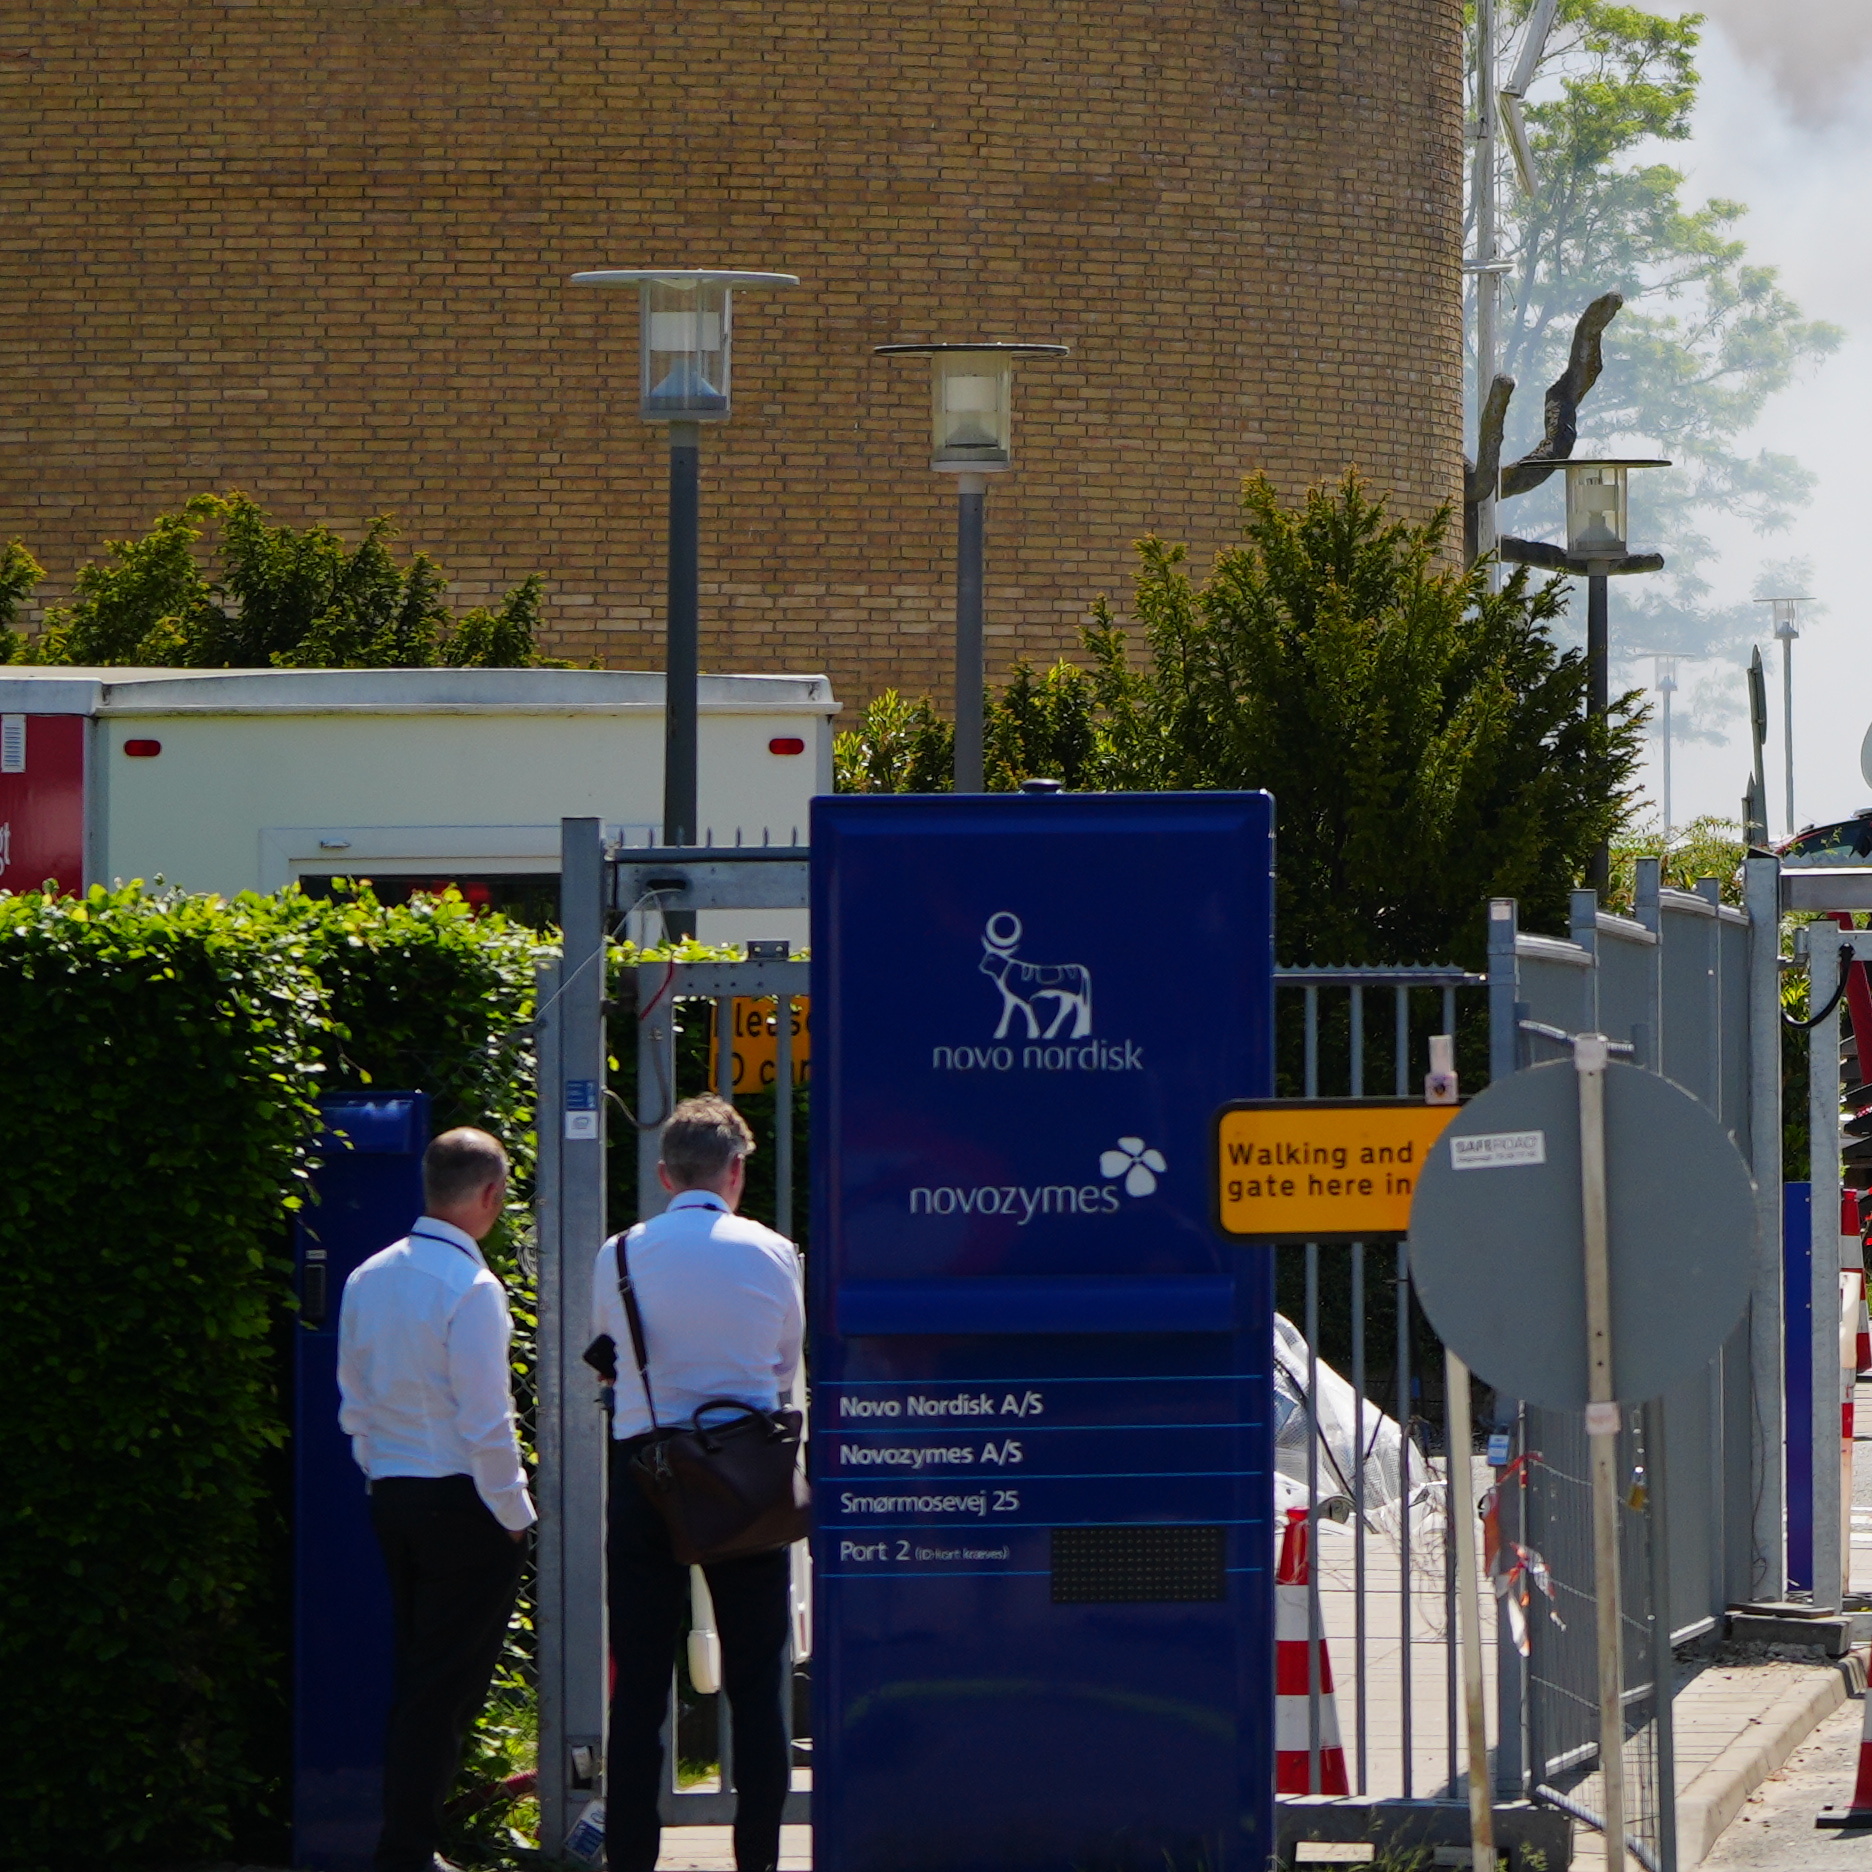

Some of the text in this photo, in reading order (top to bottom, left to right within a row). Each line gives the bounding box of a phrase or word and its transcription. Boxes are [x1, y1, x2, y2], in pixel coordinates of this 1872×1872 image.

[932, 1038, 1144, 1071] novo nordisk
[1228, 1140, 1348, 1170] Walking
[1360, 1140, 1413, 1165] and
[1227, 1174, 1295, 1203] gate
[1308, 1173, 1374, 1196] here
[909, 1184, 1120, 1226] novozymes
[839, 1390, 1045, 1418] Novo Nordisk A/S
[839, 1438, 1024, 1470] Novozymes A/S
[840, 1489, 1021, 1517] Smørmosevej 25
[839, 1539, 889, 1561] Port
[895, 1539, 912, 1561] 2
